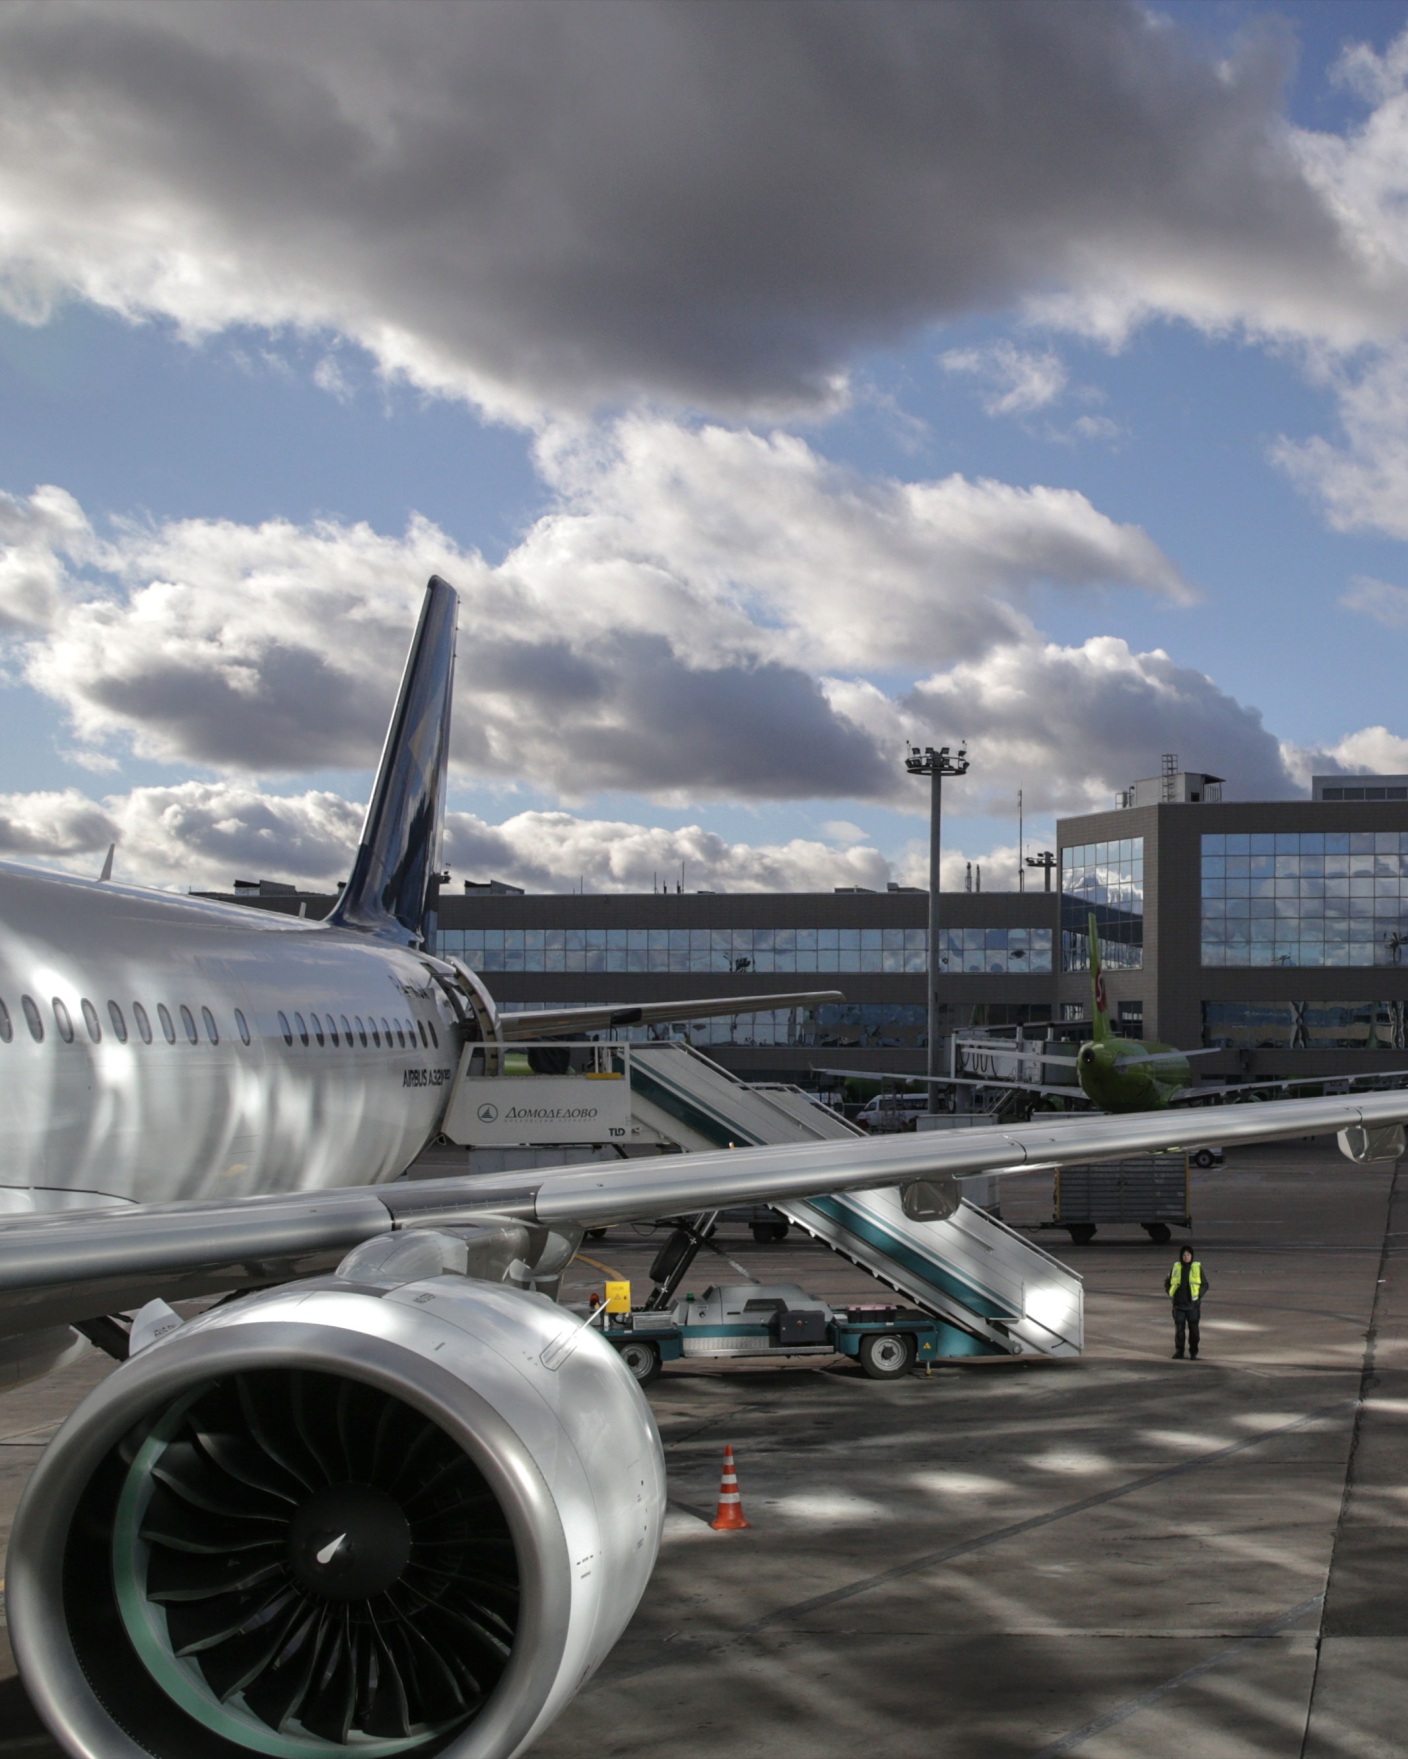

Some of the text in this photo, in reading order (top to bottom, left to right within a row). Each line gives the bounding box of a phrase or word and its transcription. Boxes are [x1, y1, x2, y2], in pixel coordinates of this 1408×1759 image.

[402, 1068, 427, 1087] AIRBUS
[505, 1106, 598, 1119] ДОМОДЕДОВО
[608, 1128, 625, 1136] TLD
